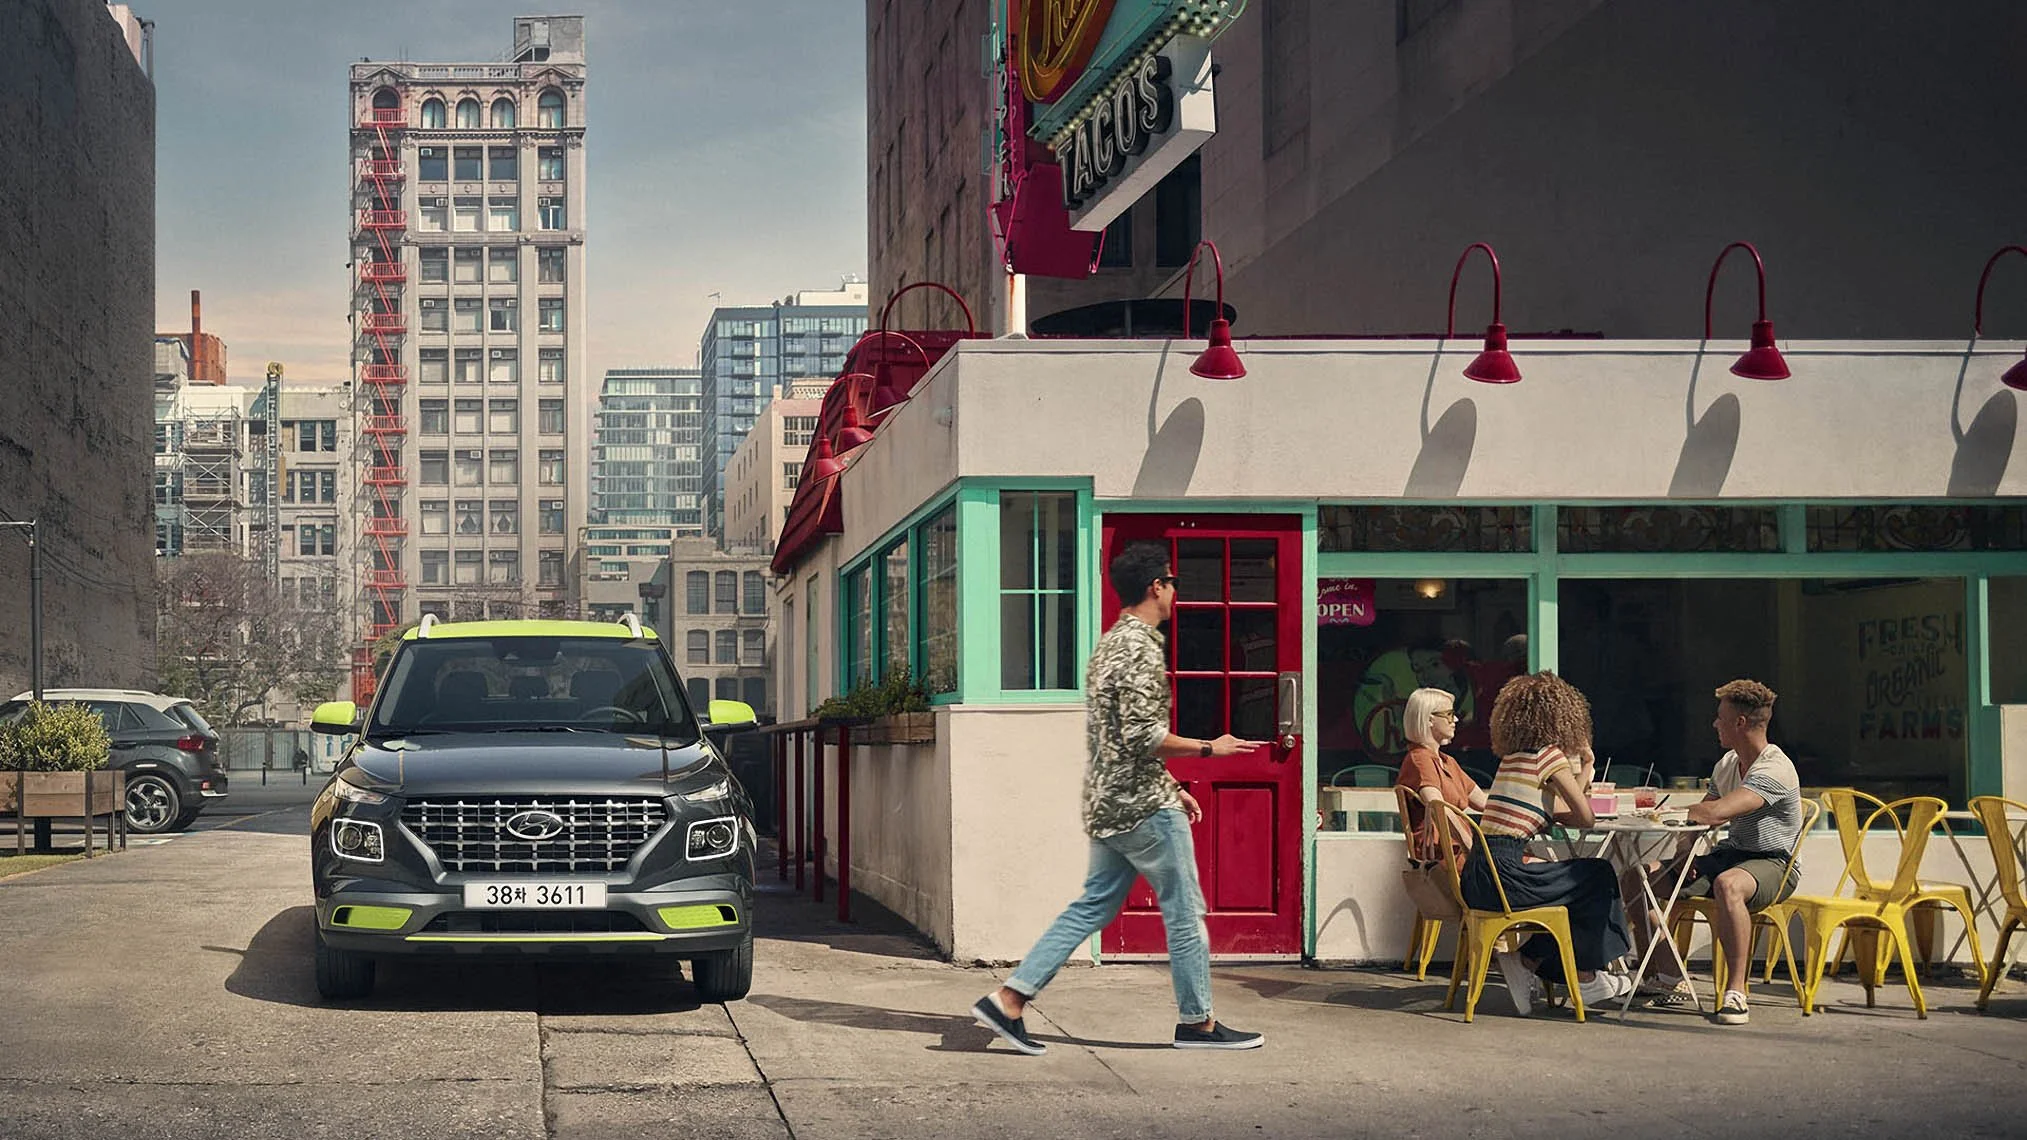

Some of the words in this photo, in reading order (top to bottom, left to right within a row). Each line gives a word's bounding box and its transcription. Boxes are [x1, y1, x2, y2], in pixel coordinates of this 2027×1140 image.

[1055, 54, 1164, 209] TACOS
[1317, 603, 1365, 617] OPEN
[1858, 613, 1963, 662] FRESH
[1866, 649, 1946, 709] ORGANIC
[1859, 709, 1963, 740] FARMS
[487, 885, 527, 905] 38차
[536, 885, 585, 905] 3611
